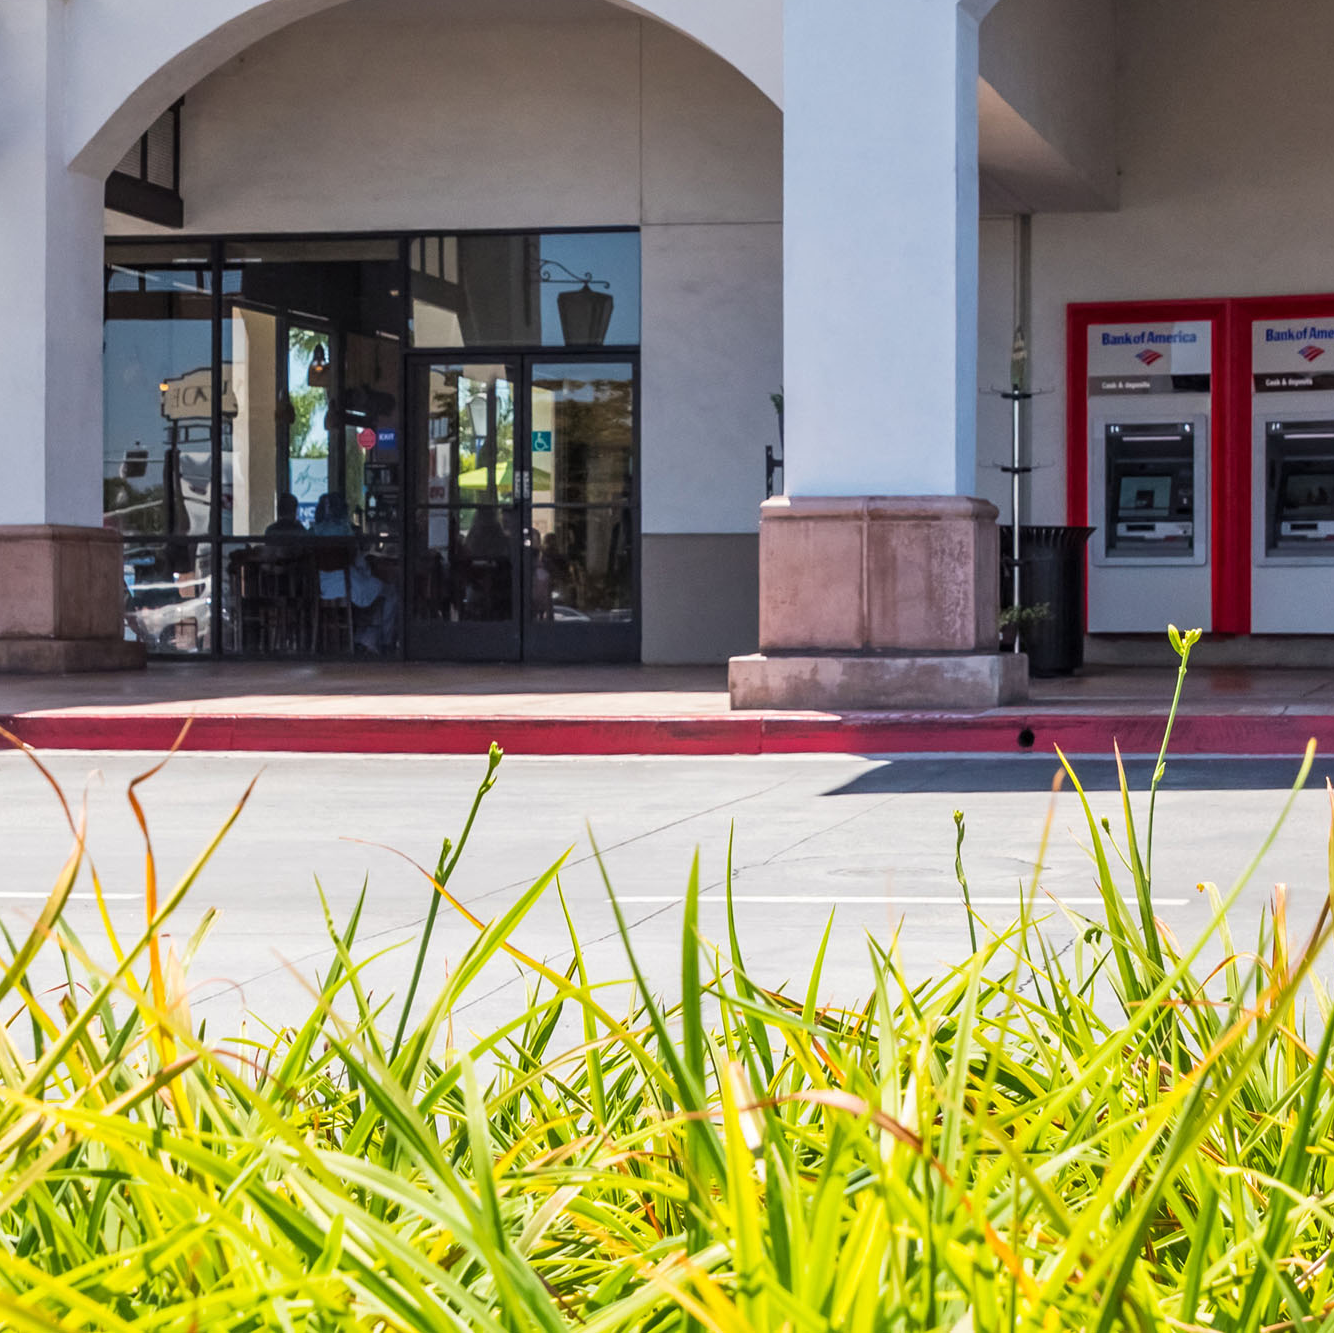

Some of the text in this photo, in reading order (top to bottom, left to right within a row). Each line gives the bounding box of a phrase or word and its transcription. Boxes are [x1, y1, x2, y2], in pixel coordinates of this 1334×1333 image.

[1102, 329, 1197, 345] Bank of America
[1265, 328, 1295, 341] Bank
[1296, 327, 1308, 340] of
